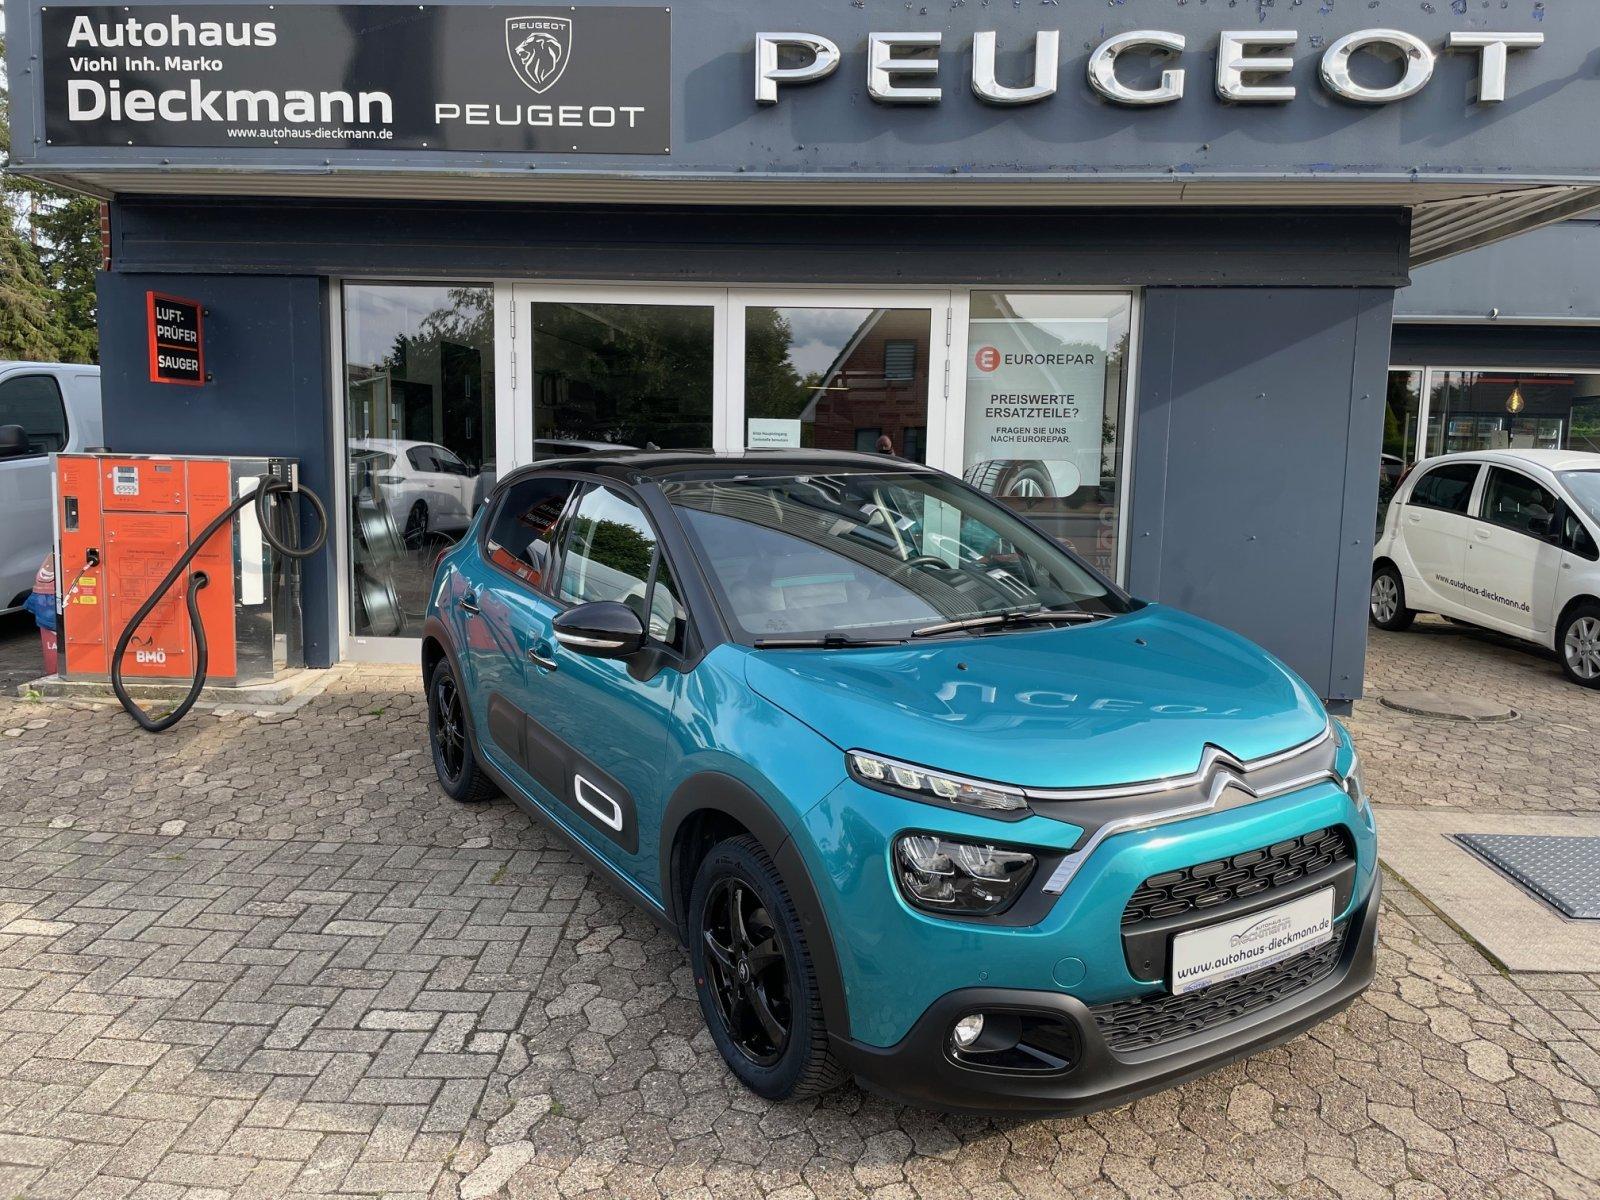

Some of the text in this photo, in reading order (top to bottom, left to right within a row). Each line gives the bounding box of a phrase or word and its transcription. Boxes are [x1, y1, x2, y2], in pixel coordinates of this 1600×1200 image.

[67, 15, 277, 48] Autohaus
[511, 22, 567, 31] PEUGEOT
[69, 56, 223, 72] Viohl Inh. Marko
[755, 28, 1545, 104] PEUGEOT
[67, 78, 393, 124] Dieckmann
[435, 103, 645, 128] PEUGEOT
[227, 127, 393, 140] www.autohaus-dieckmann.de
[156, 306, 185, 323] LUFT-
[157, 325, 197, 342] PRÜFER
[158, 355, 198, 371] SAUGER
[1004, 354, 1095, 365] EUROREPAR
[990, 394, 1075, 405] PREISWERTE
[985, 407, 1079, 418] ERSATZTEILE?
[990, 435, 1072, 443] NACH EUROREPAR.
[996, 427, 1067, 435] FRAGEN SIE UNS
[1434, 573, 1531, 613] www.autohaus-dieckmann.de
[136, 648, 167, 664] BMÖ
[1177, 917, 1330, 979] www.autohaus-dieckmann.de
